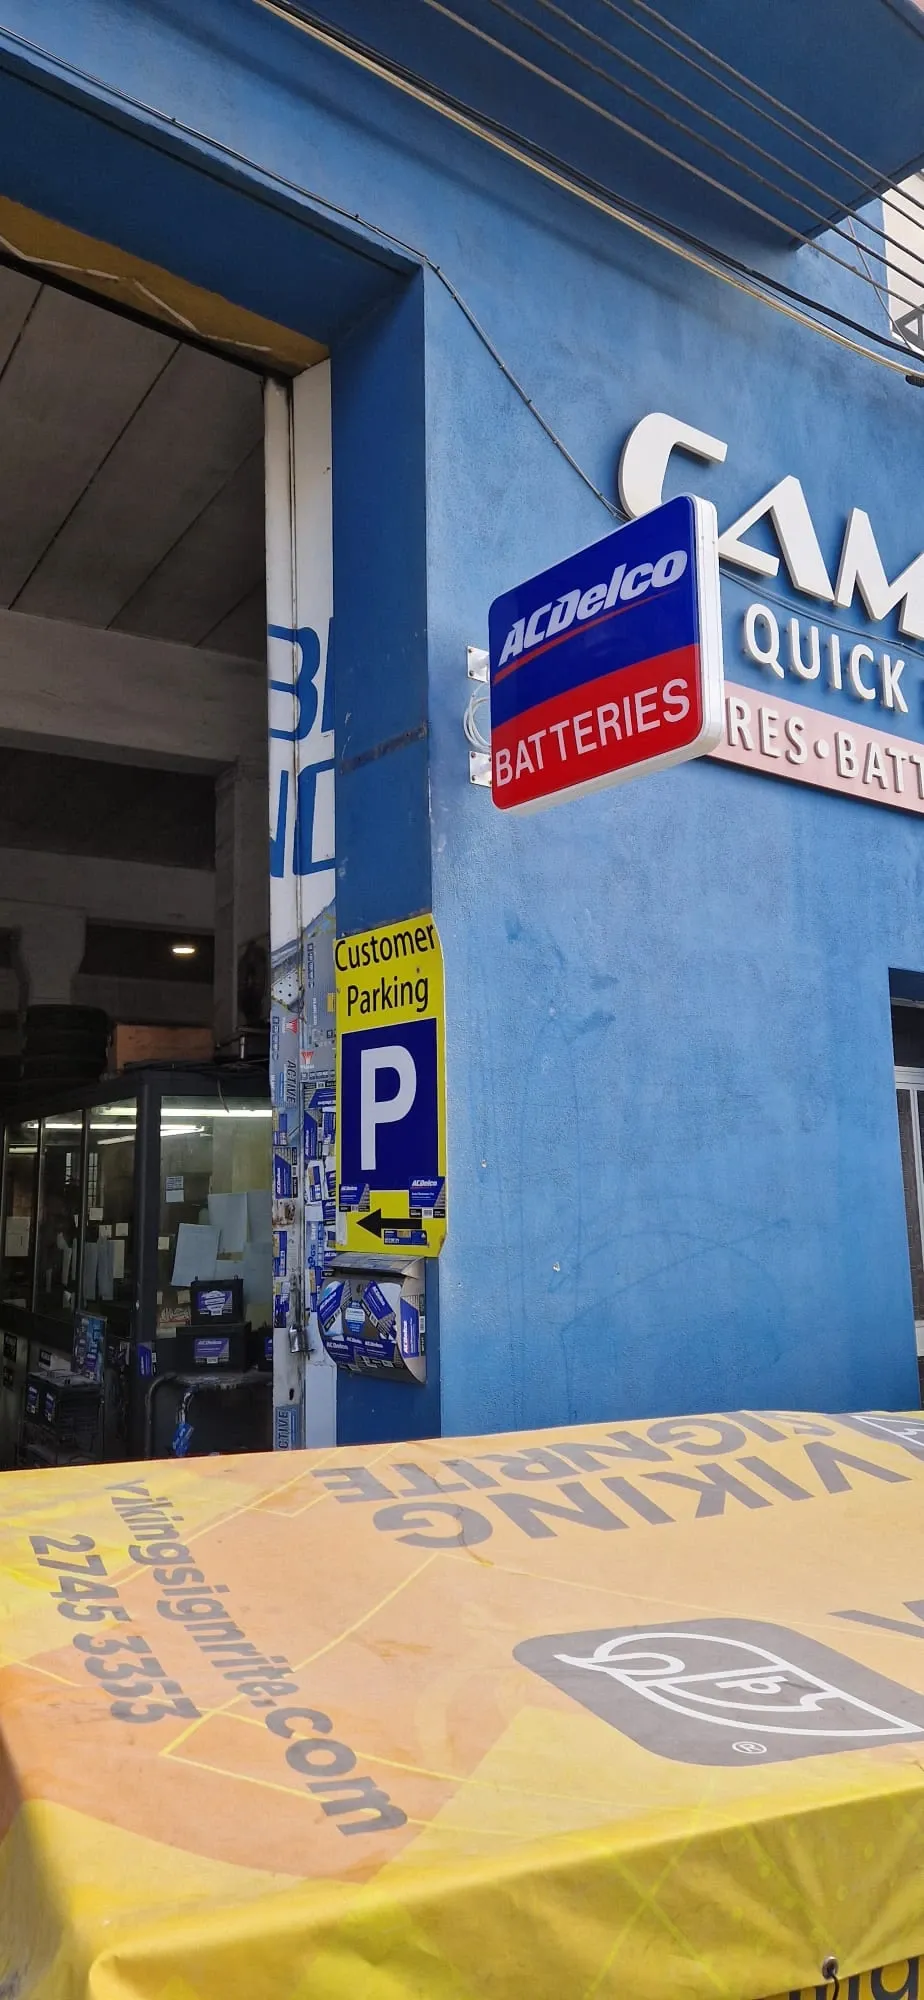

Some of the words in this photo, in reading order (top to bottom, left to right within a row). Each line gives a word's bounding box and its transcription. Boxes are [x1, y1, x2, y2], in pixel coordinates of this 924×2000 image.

[499, 550, 688, 667] ACDelco
[743, 602, 909, 713] QUICK
[495, 678, 691, 787] BATTERIES
[335, 924, 436, 972] Customer
[347, 976, 429, 1017] Parking
[285, 1060, 297, 1104] ACTIVE
[360, 1045, 417, 1170] P
[311, 1410, 836, 1503] SIGNRITE
[372, 1441, 912, 1549] VIKING
[28, 1534, 132, 1623] 2745
[72, 1635, 204, 1724] 3353
[104, 1480, 408, 1837] vikingsignrite.com
